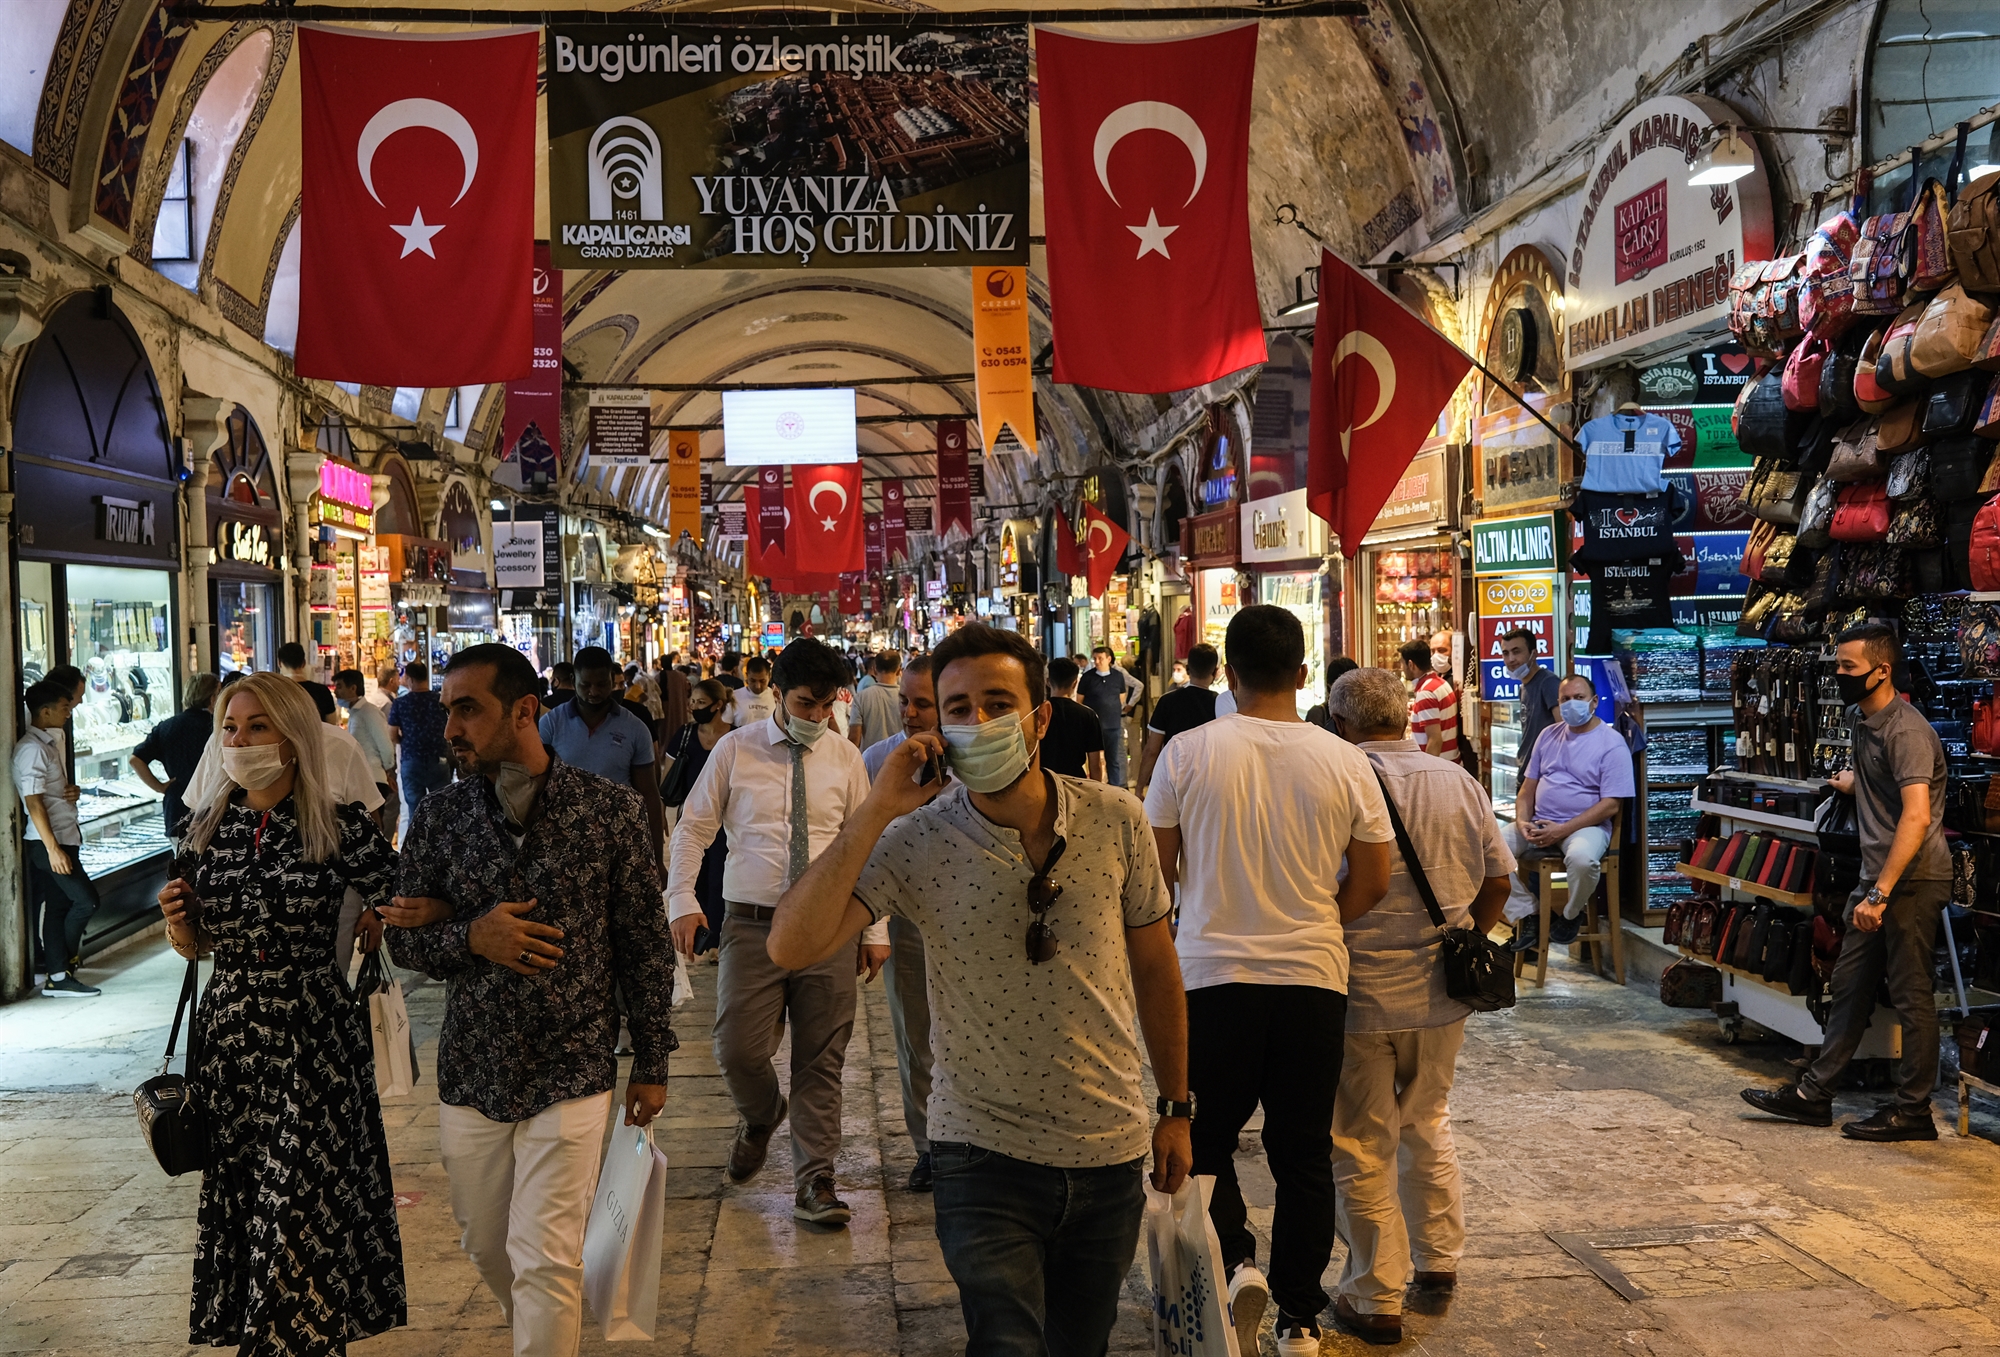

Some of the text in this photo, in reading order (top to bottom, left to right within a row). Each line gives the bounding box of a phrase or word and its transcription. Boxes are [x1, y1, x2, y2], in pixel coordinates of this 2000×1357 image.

[555, 33, 931, 83] Bugünleri özlemiştik...
[1630, 113, 1734, 226] KAPALIÇŞI
[691, 174, 900, 215] YUVANIZA
[615, 209, 638, 220] 1461
[1619, 187, 1663, 232] KAPALI
[732, 203, 1016, 263] HOŞ GELDİNİZ
[1622, 217, 1660, 263] ÇARŞI
[580, 246, 674, 259] GRAND BAZAAR
[1669, 239, 1706, 263] KURULUŞ: 1952
[1569, 292, 1649, 351] ESNAFLARI
[533, 347, 553, 356] 530
[995, 346, 1022, 355] 0543
[981, 357, 1027, 368] 630 0574
[1701, 353, 1718, 375] I
[1638, 367, 1697, 385] ISTANBUL
[1703, 375, 1749, 385] ISTANBU
[1693, 413, 1732, 430] ISTAN
[1706, 430, 1735, 440] TURK
[102, 495, 139, 543] TRUVA
[1599, 526, 1658, 539] ISTANBUL
[512, 536, 536, 546] Silver
[1476, 530, 1509, 564] ALTIN
[1509, 525, 1553, 562] ALINIR
[495, 549, 537, 559] Jewellery
[1697, 545, 1744, 563] Istanb
[495, 563, 537, 573] ccessory
[1604, 565, 1651, 578] ISTANBUL
[1489, 588, 1545, 599] 14 18 22
[1501, 603, 1535, 614] AYAR
[1672, 610, 1697, 625] nbul
[1708, 610, 1742, 626] ISTANB
[1494, 619, 1545, 637] ALTIN
[606, 1190, 630, 1244] GIZIA
